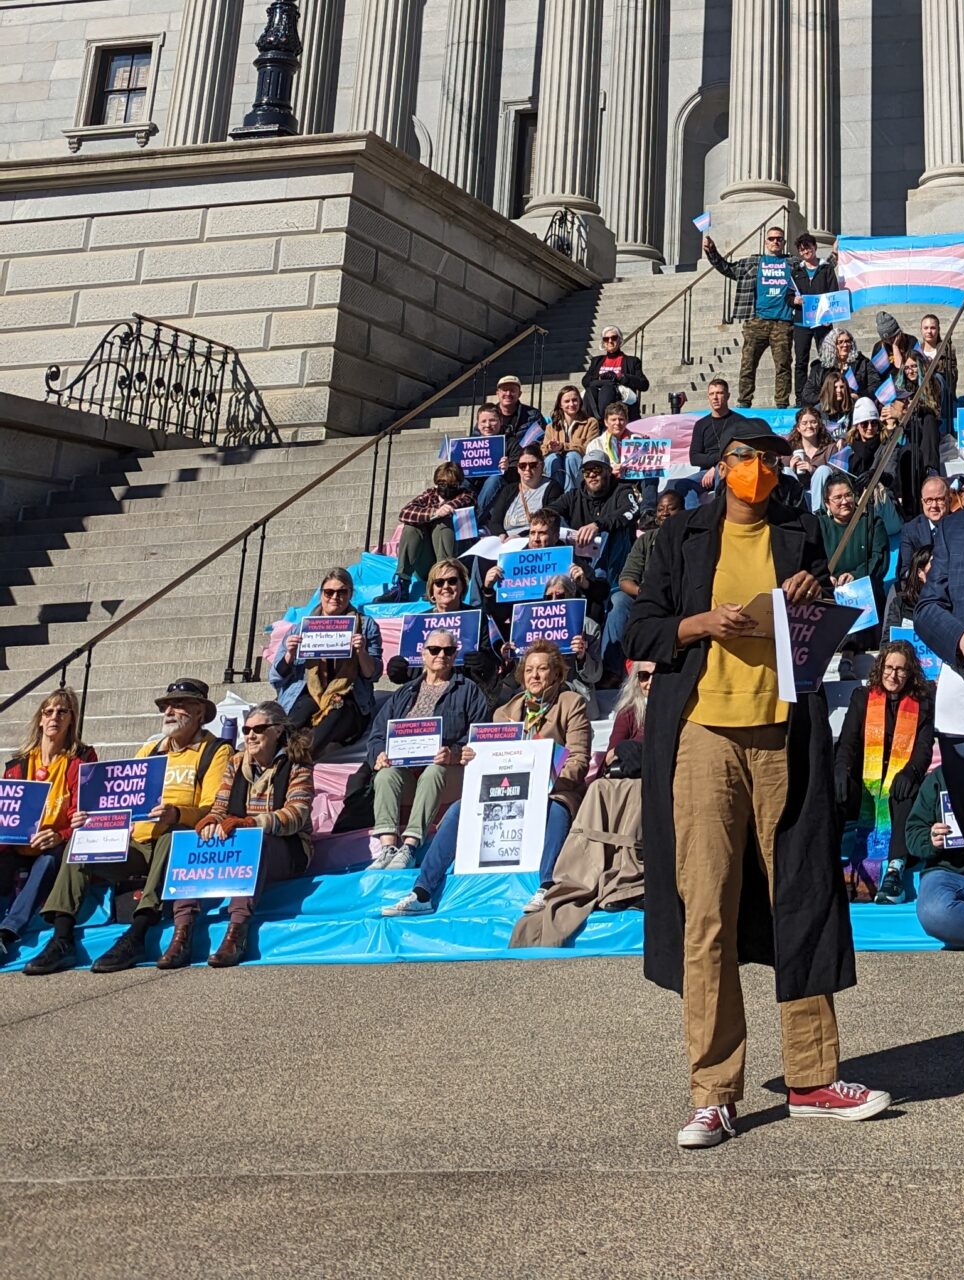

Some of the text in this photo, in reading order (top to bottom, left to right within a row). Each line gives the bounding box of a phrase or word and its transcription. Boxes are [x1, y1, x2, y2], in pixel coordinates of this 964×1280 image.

[762, 269, 785, 277] With
[462, 440, 490, 449] TRANS
[462, 449, 490, 458] YOUTH
[460, 458, 493, 468] BELONG
[519, 552, 552, 564] DON'T
[513, 563, 557, 576] DISRUPT
[501, 575, 537, 588] TRANS
[531, 604, 566, 617] TRANS
[424, 616, 462, 629] TRANS
[530, 616, 566, 630] YOUTH
[105, 762, 149, 778] TRANS
[104, 778, 146, 793] YOUTH
[99, 793, 146, 808] BELONG
[483, 821, 503, 835] Fight
[483, 840, 496, 848] Not
[187, 850, 242, 865] DISRUPT
[497, 847, 520, 857] GAYS
[171, 866, 253, 881] TRANS LIVES
